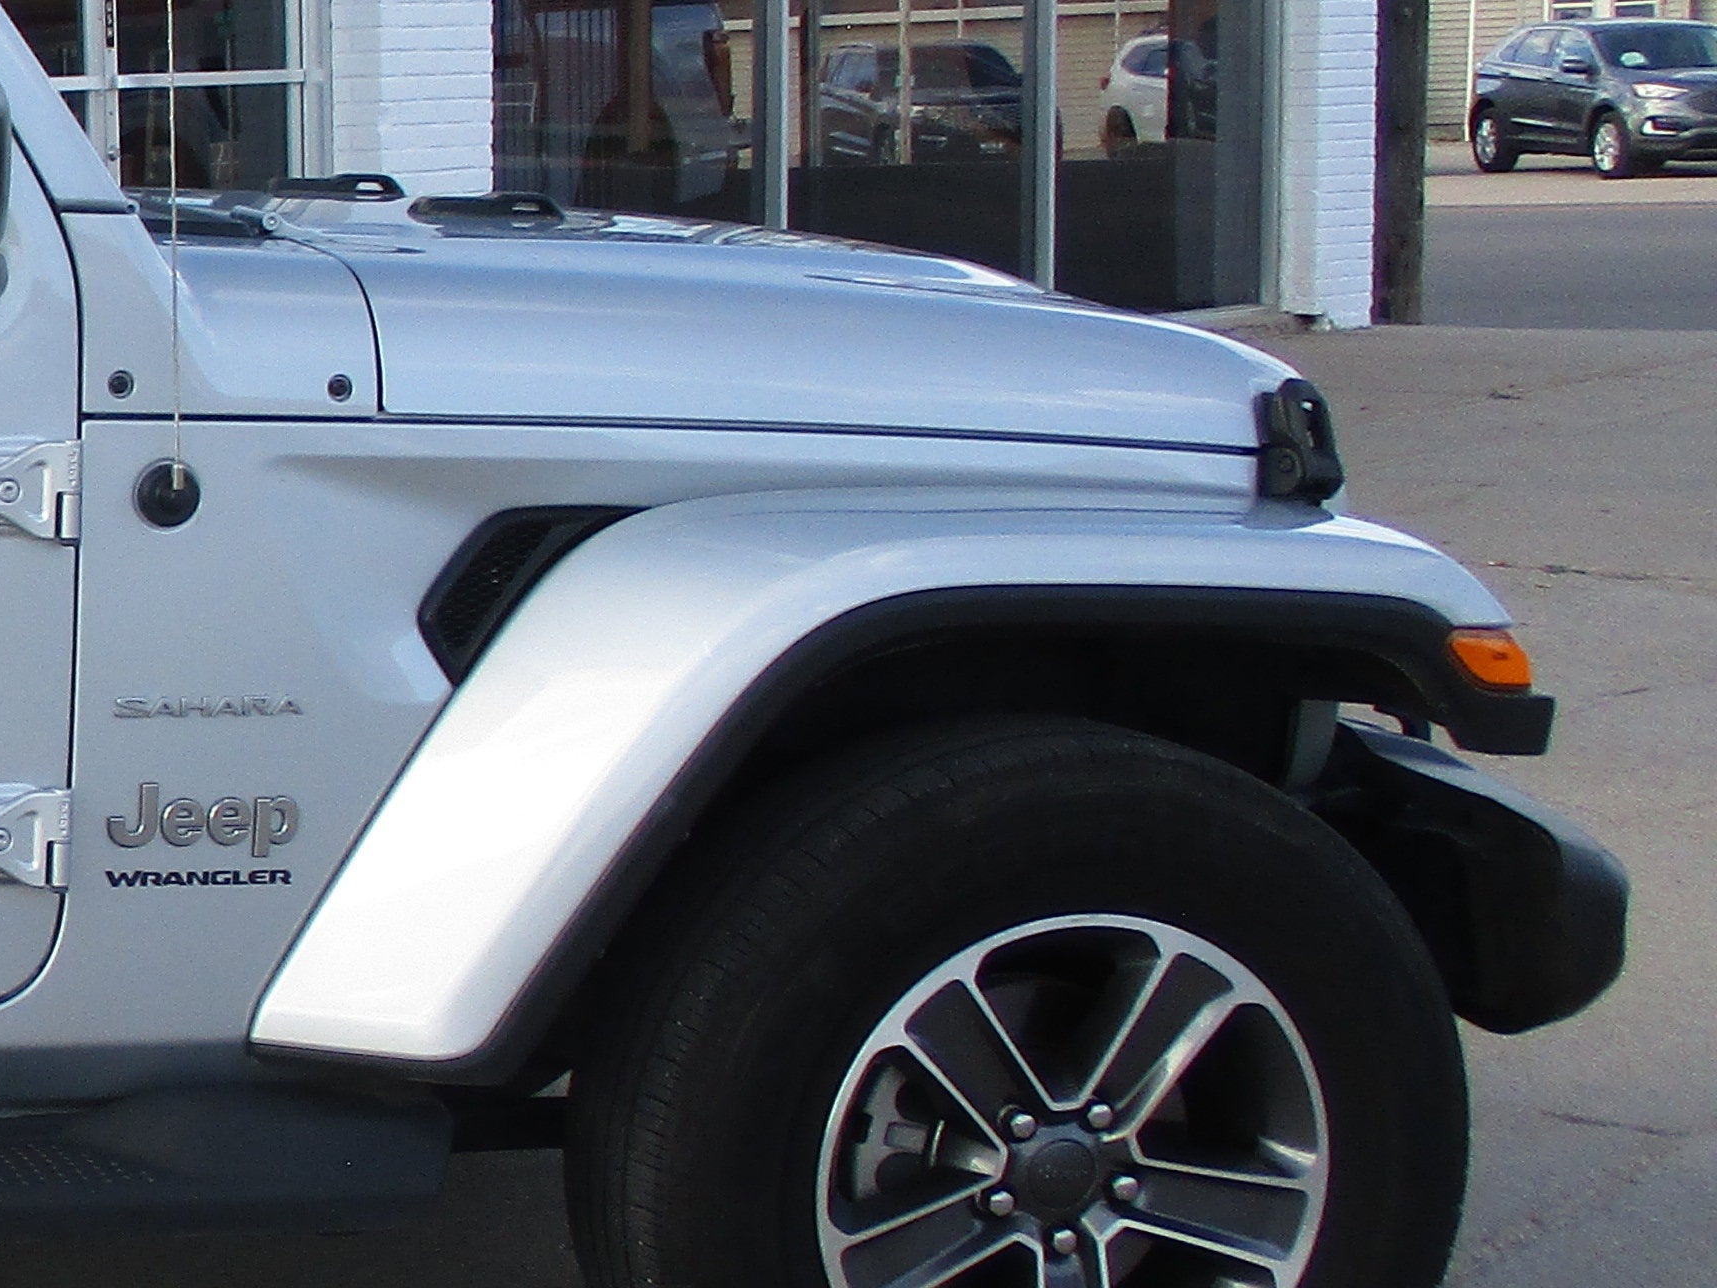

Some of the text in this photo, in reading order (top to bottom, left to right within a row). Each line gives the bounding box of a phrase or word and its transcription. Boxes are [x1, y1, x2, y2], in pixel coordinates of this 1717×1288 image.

[114, 694, 303, 718] SAHARA
[106, 782, 300, 858] Jeep
[104, 869, 293, 888] WRANGLER
